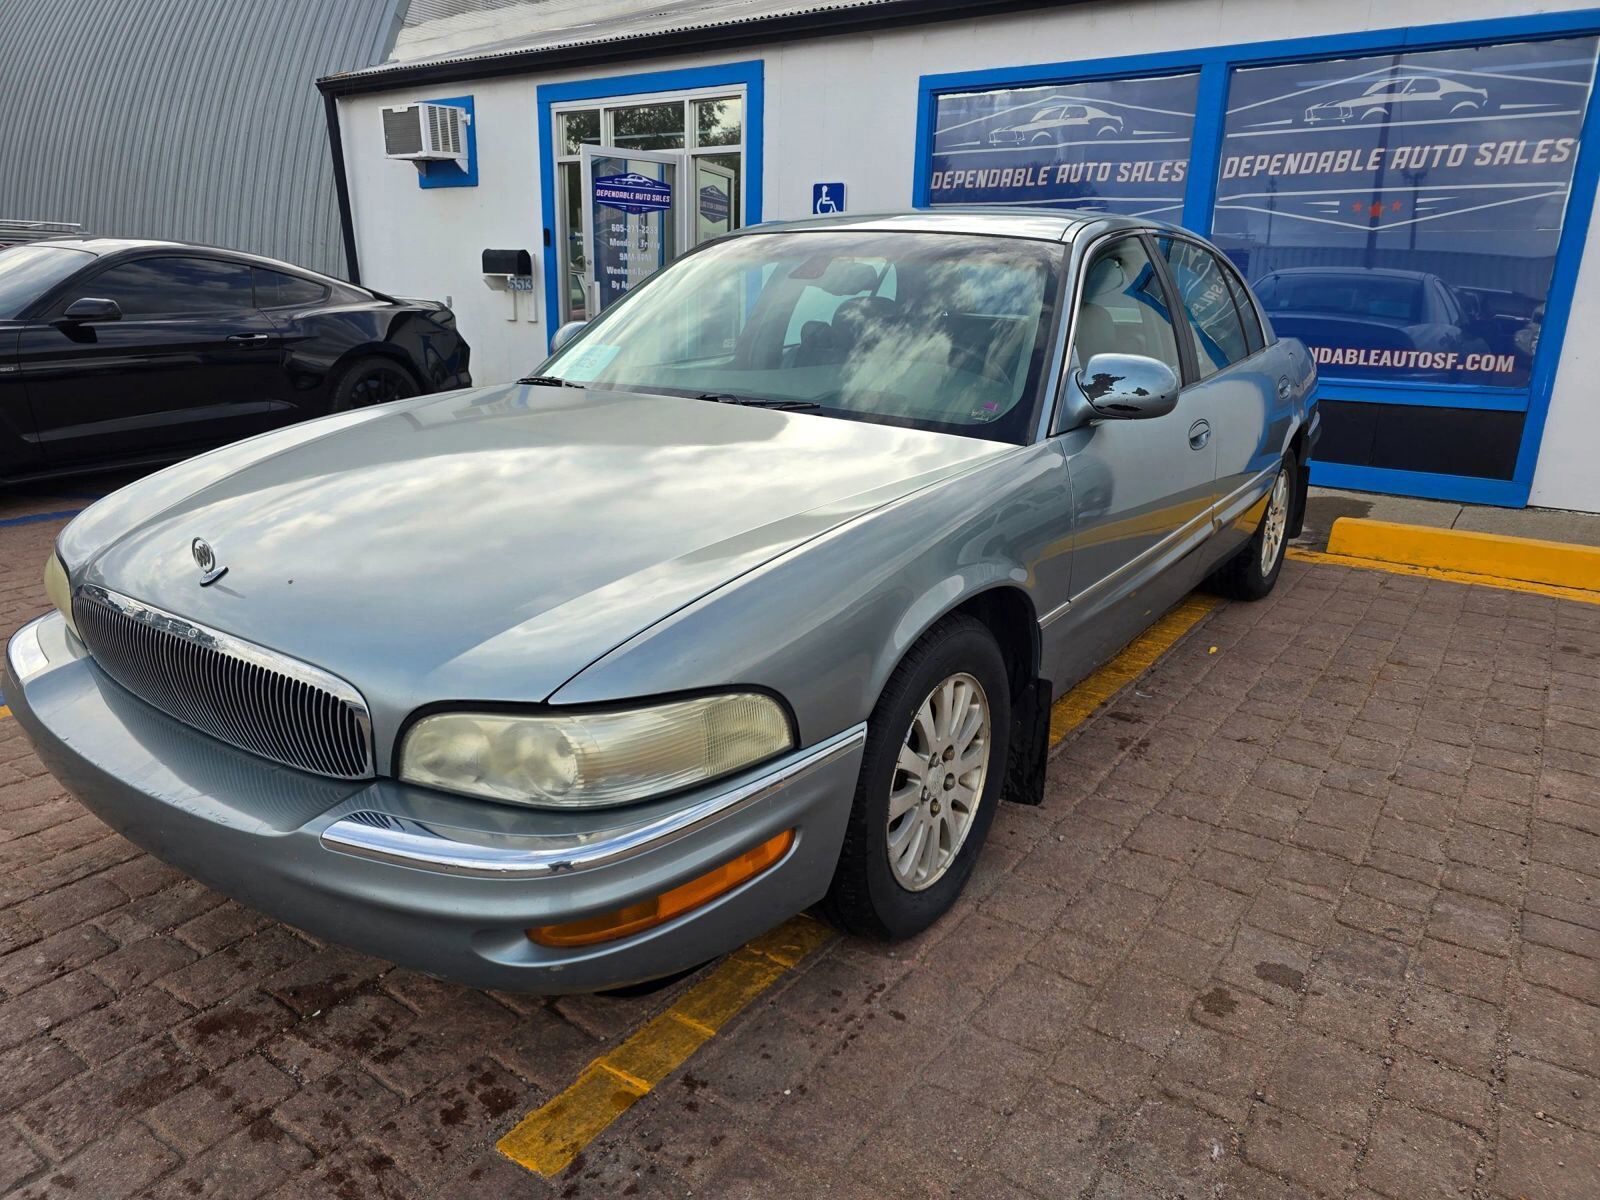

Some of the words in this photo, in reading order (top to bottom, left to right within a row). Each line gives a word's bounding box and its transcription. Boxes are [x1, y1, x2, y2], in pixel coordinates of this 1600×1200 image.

[1222, 147, 1385, 179] DEPENDABLE
[1390, 143, 1468, 170] AUTO
[1474, 138, 1576, 167] SALES
[930, 166, 1050, 189] DEPENDABLE
[1055, 162, 1110, 184] AUTO
[1116, 160, 1187, 183] SALES
[596, 189, 634, 200] DEPENDABLE
[635, 193, 651, 201] AUTO
